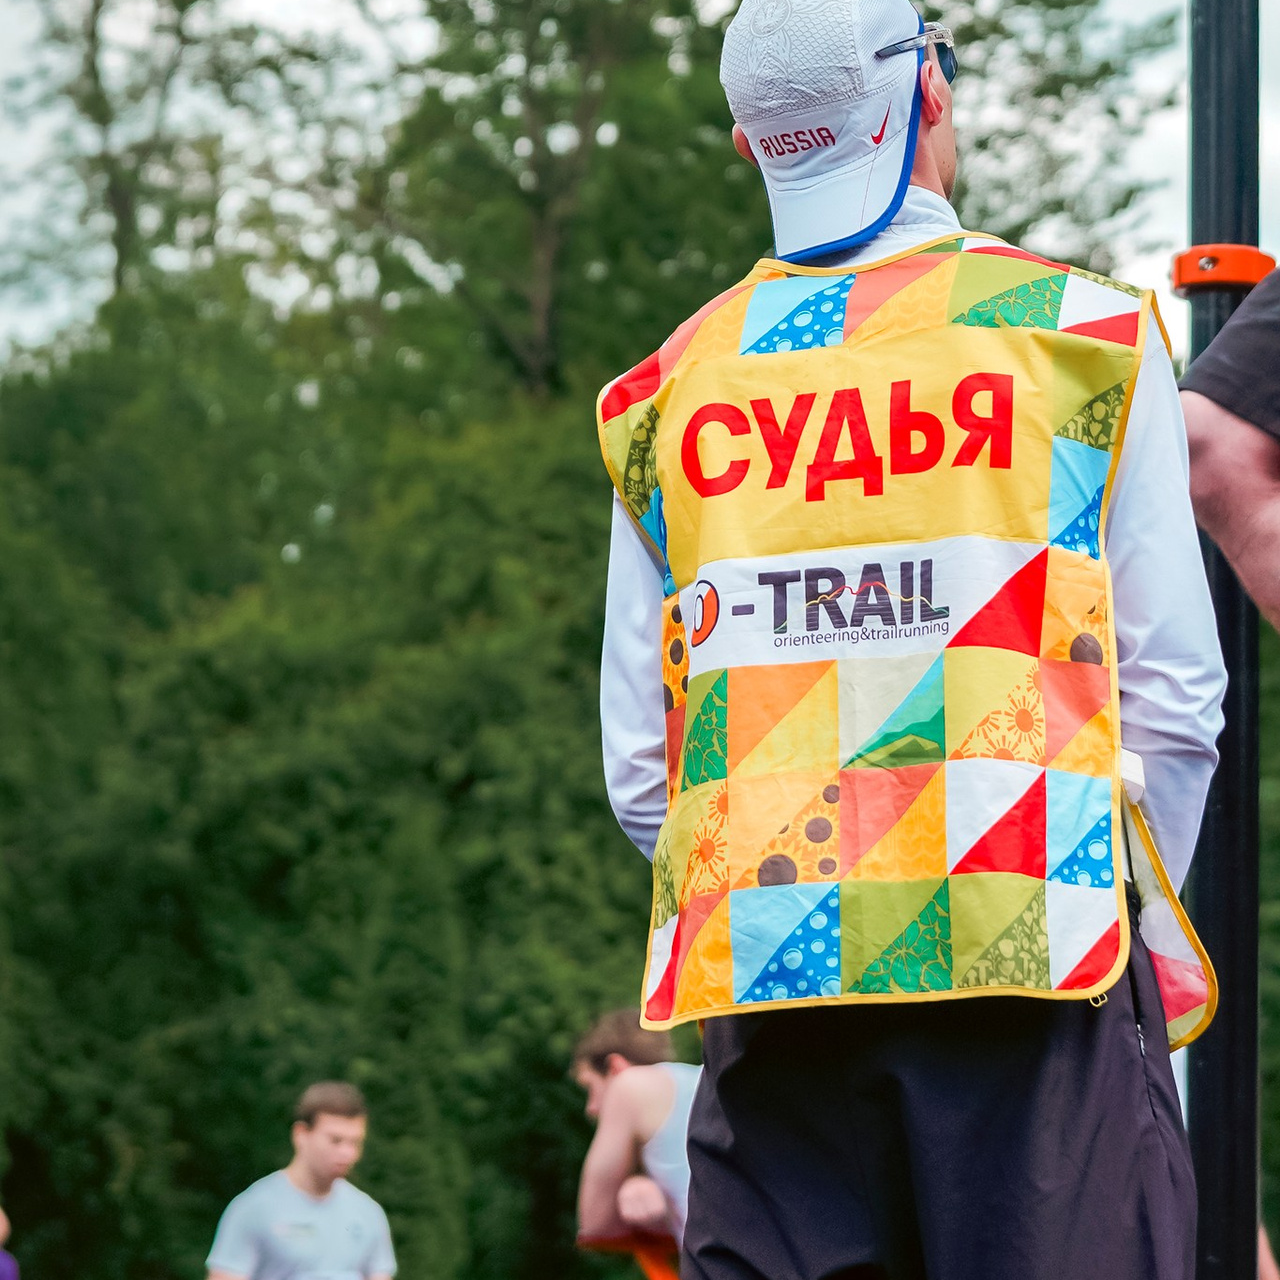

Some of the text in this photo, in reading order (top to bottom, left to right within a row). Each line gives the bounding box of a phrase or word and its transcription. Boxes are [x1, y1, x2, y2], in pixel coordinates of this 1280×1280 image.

[759, 126, 836, 159] RUSSIA
[681, 372, 1014, 502] СУДЬЯ
[773, 620, 950, 648] orienteering&trailrunning
